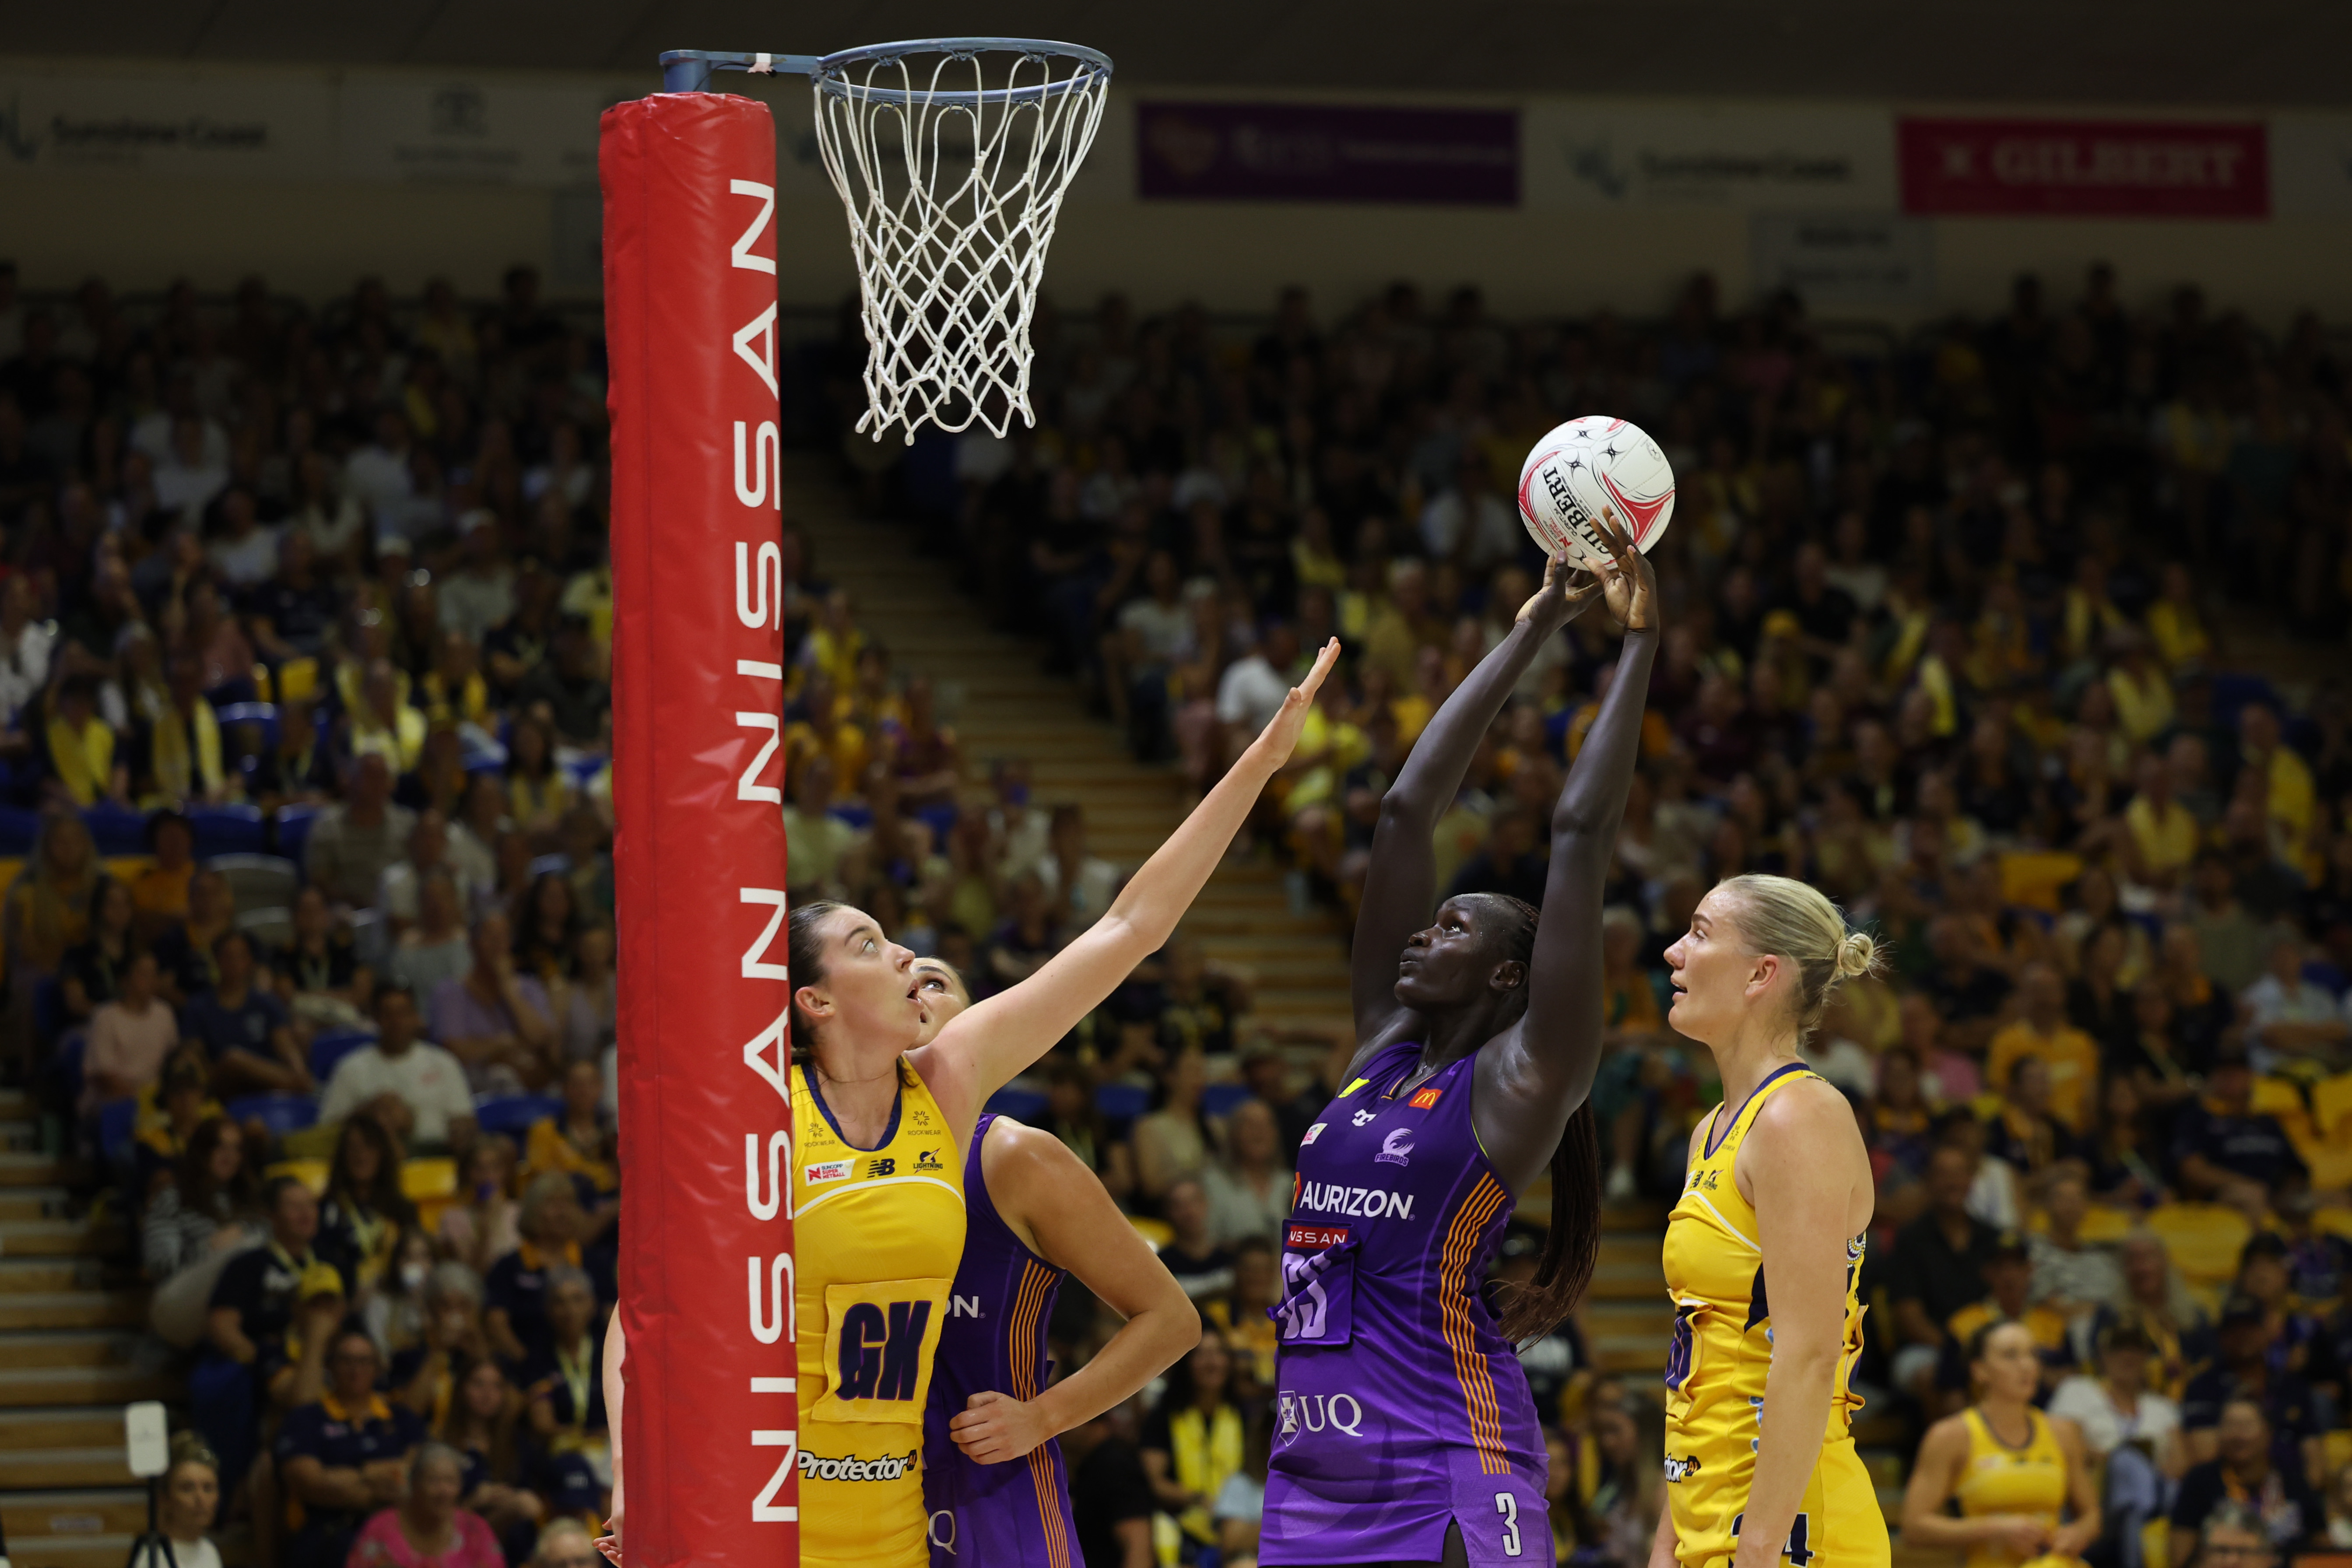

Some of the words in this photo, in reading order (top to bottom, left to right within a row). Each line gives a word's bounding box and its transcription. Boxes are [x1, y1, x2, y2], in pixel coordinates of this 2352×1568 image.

[1992, 138, 2245, 188] GILBERT
[730, 179, 783, 805] NISSAN
[1554, 507, 1577, 537] QUANTUM
[804, 1140, 835, 1148] ROCKWEAR
[1376, 1154, 1408, 1165] FIREBIRDS
[740, 887, 798, 1522] NISSAN
[1300, 1181, 1414, 1220] AURIZON
[835, 1301, 932, 1401] GK
[1299, 1393, 1363, 1437] UQ
[798, 1450, 909, 1481] Protector
[1495, 1492, 1522, 1556] 3
